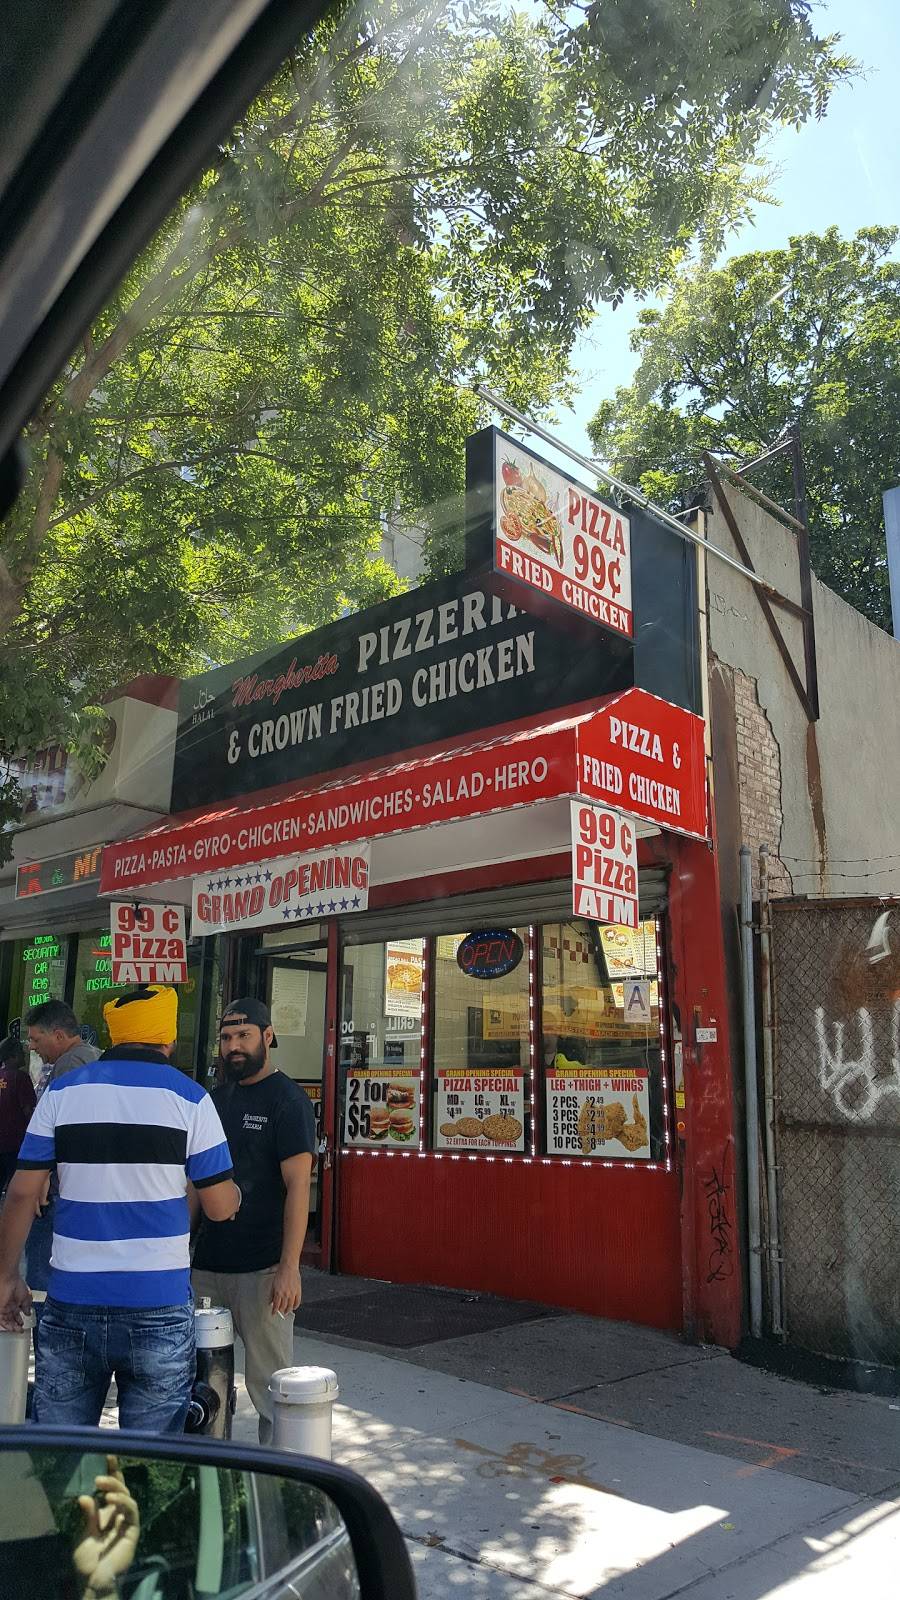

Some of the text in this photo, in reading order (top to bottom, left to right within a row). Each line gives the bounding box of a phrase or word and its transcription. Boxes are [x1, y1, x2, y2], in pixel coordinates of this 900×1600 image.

[568, 487, 626, 556] PIZZA
[572, 534, 622, 599] 99¢
[500, 544, 629, 633] FRIED CHICKEN
[231, 653, 340, 708] Margherita
[226, 631, 535, 765] & CROWN FRIED CHICKEN
[192, 709, 215, 725] HALAL
[608, 715, 681, 770] PIZZA &
[494, 756, 548, 792] HERO
[583, 754, 681, 816] FRIED CHICKEN
[576, 843, 636, 895] Pizza
[197, 856, 369, 925] GRAND OPENING
[578, 887, 635, 927] ATM
[23, 945, 59, 961] SECURITY
[114, 934, 184, 960] Pizza
[462, 938, 516, 967] OPEN
[117, 963, 182, 982] ATM
[627, 986, 646, 1011] A
[349, 1078, 360, 1102] 2
[364, 1079, 390, 1102] for
[443, 1079, 520, 1092] PIZZA SPECIAL
[550, 1079, 566, 1091] LEG
[611, 1079, 644, 1091] WINGS
[447, 1094, 459, 1106] MD
[474, 1094, 484, 1106] LG
[500, 1094, 509, 1106] XL
[553, 1096, 558, 1108] 2
[348, 1103, 371, 1140] $5
[553, 1109, 558, 1121] 3
[553, 1123, 559, 1135] 5
[553, 1136, 563, 1149] 10
